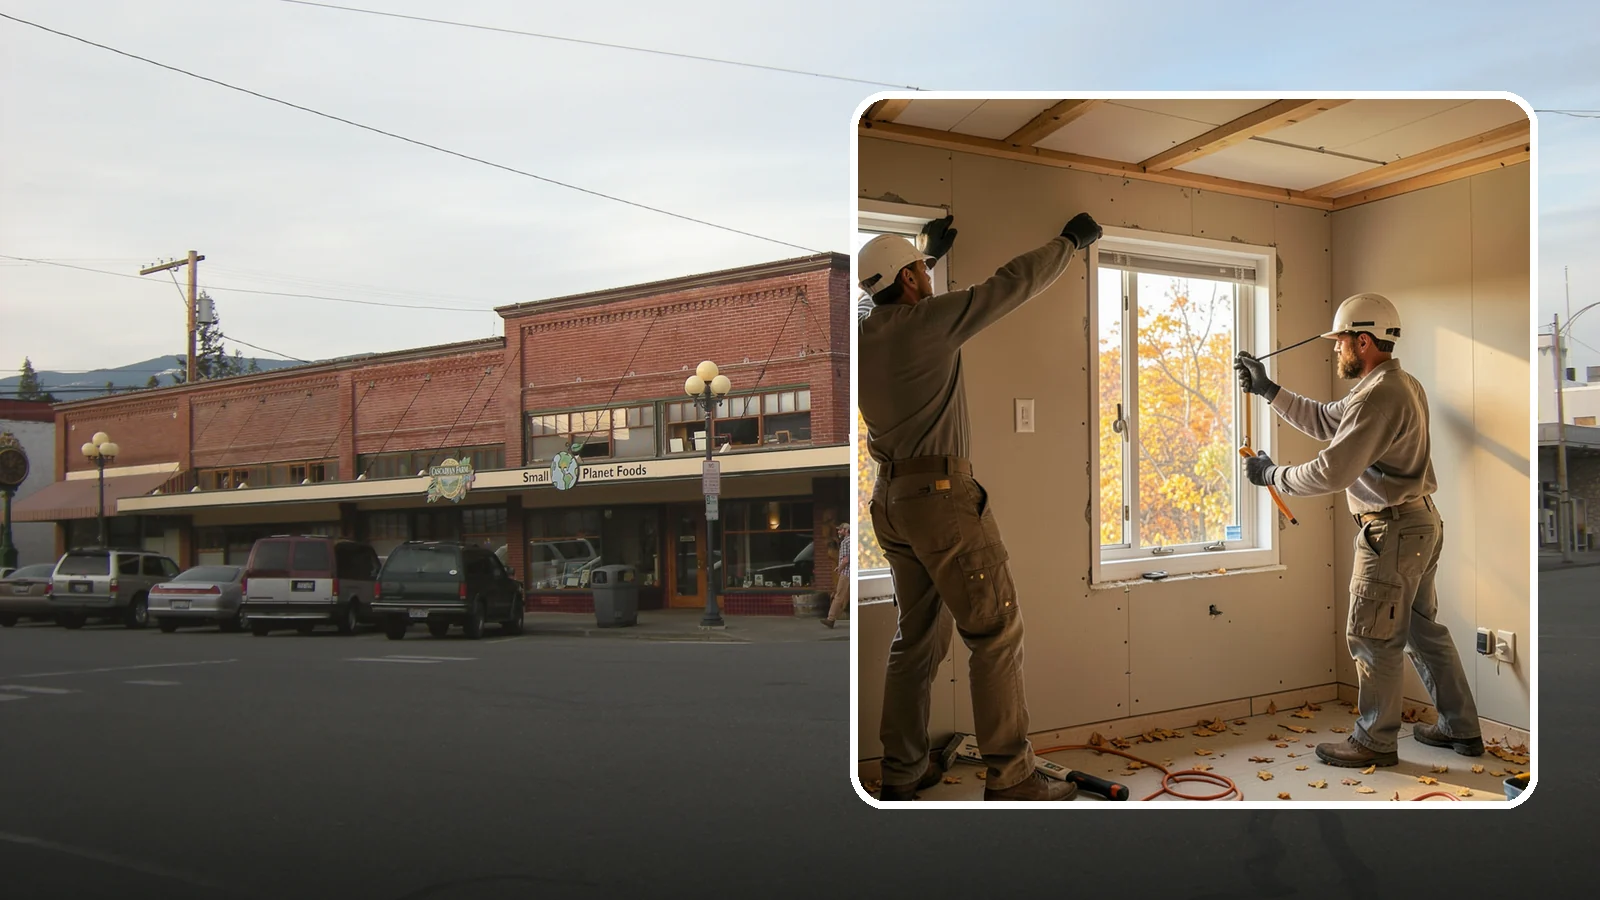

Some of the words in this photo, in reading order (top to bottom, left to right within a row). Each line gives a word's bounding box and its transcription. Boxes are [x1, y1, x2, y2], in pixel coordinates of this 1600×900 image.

[522, 471, 549, 483] Small
[582, 467, 614, 479] Planet
[616, 464, 647, 477] Foods
